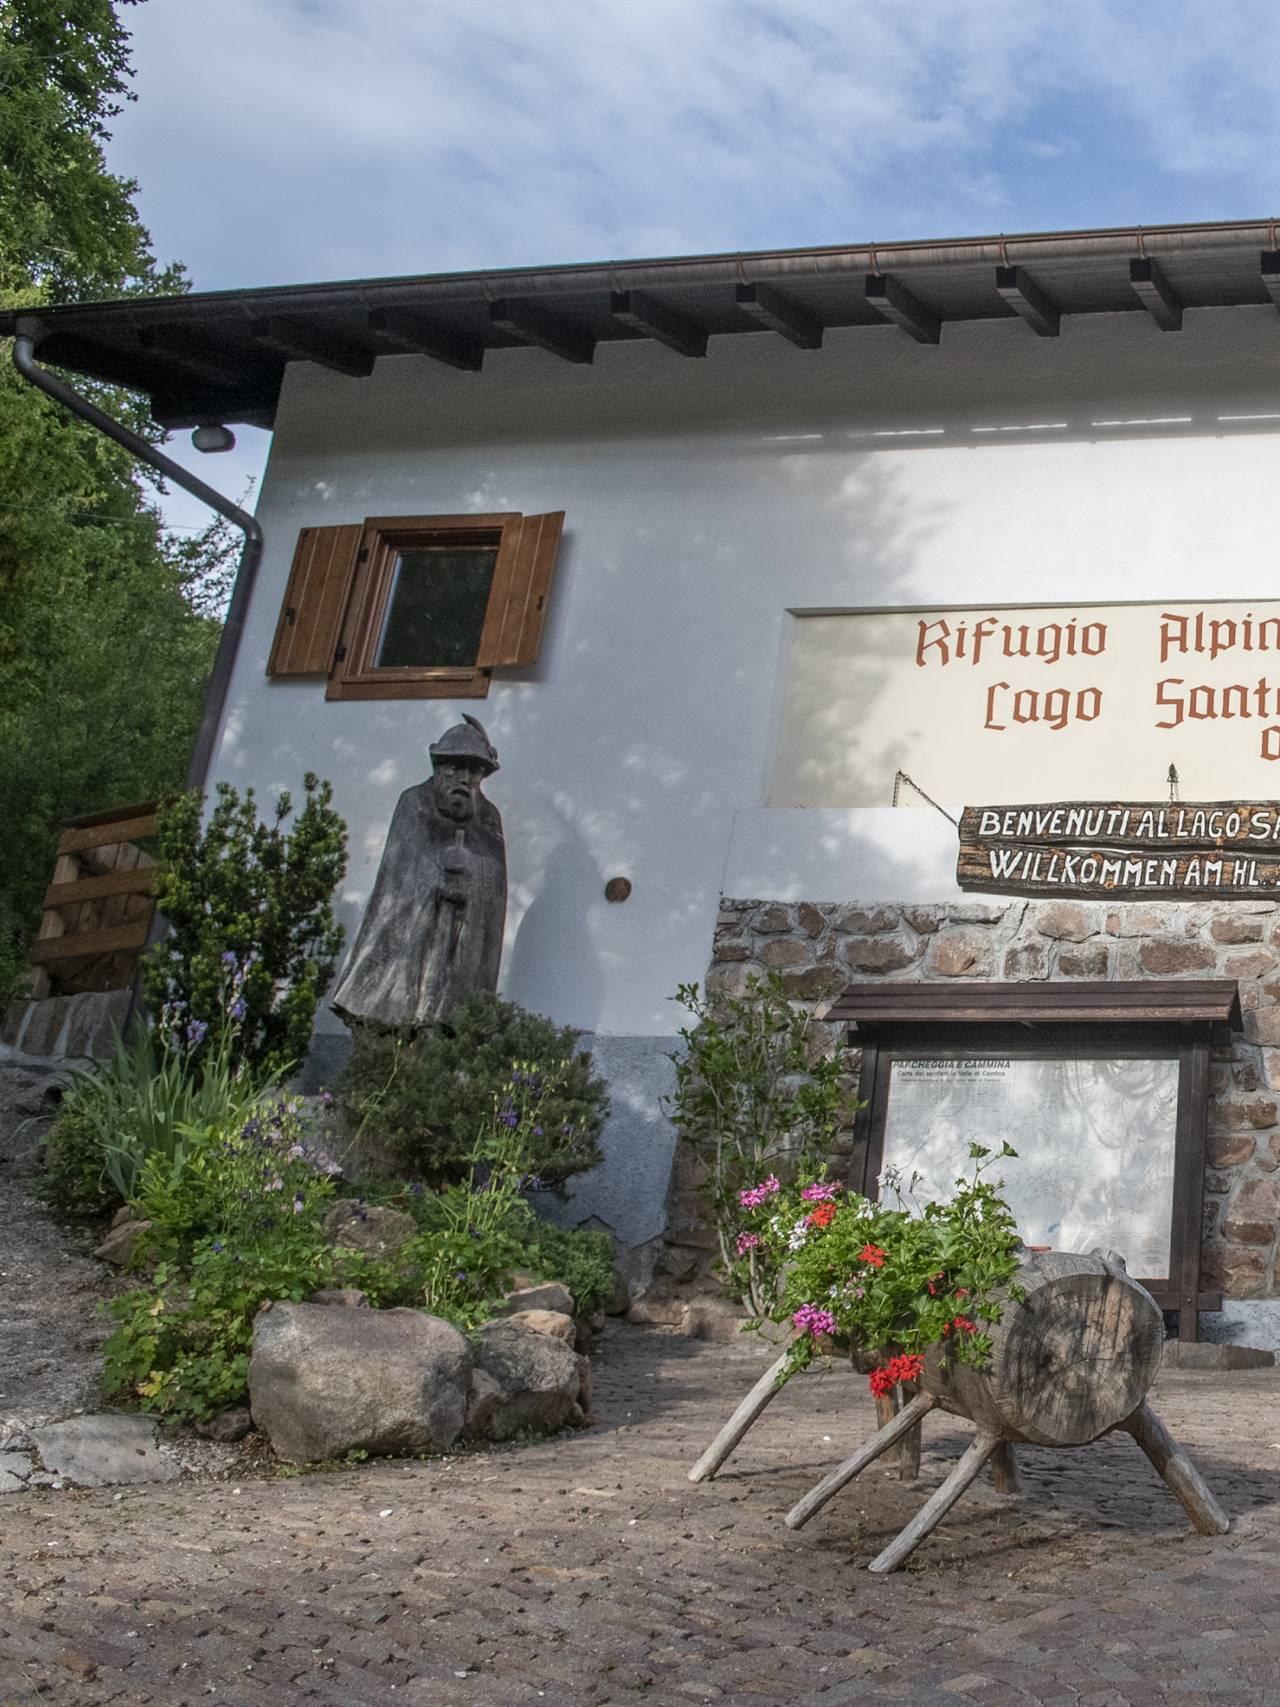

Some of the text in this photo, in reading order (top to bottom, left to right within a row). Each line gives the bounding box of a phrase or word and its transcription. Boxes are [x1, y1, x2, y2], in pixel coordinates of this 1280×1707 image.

[916, 617, 1108, 667] Rifugio
[984, 681, 1103, 731] Lago
[978, 808, 1131, 836] BENVENUTI
[1136, 810, 1169, 838] AL
[1176, 810, 1241, 838] LAGO
[989, 849, 1175, 886] WILLKOMMEN
[1184, 859, 1223, 886] AM
[1233, 859, 1267, 886] HL.
[964, 1060, 1011, 1069] CAMMINA
